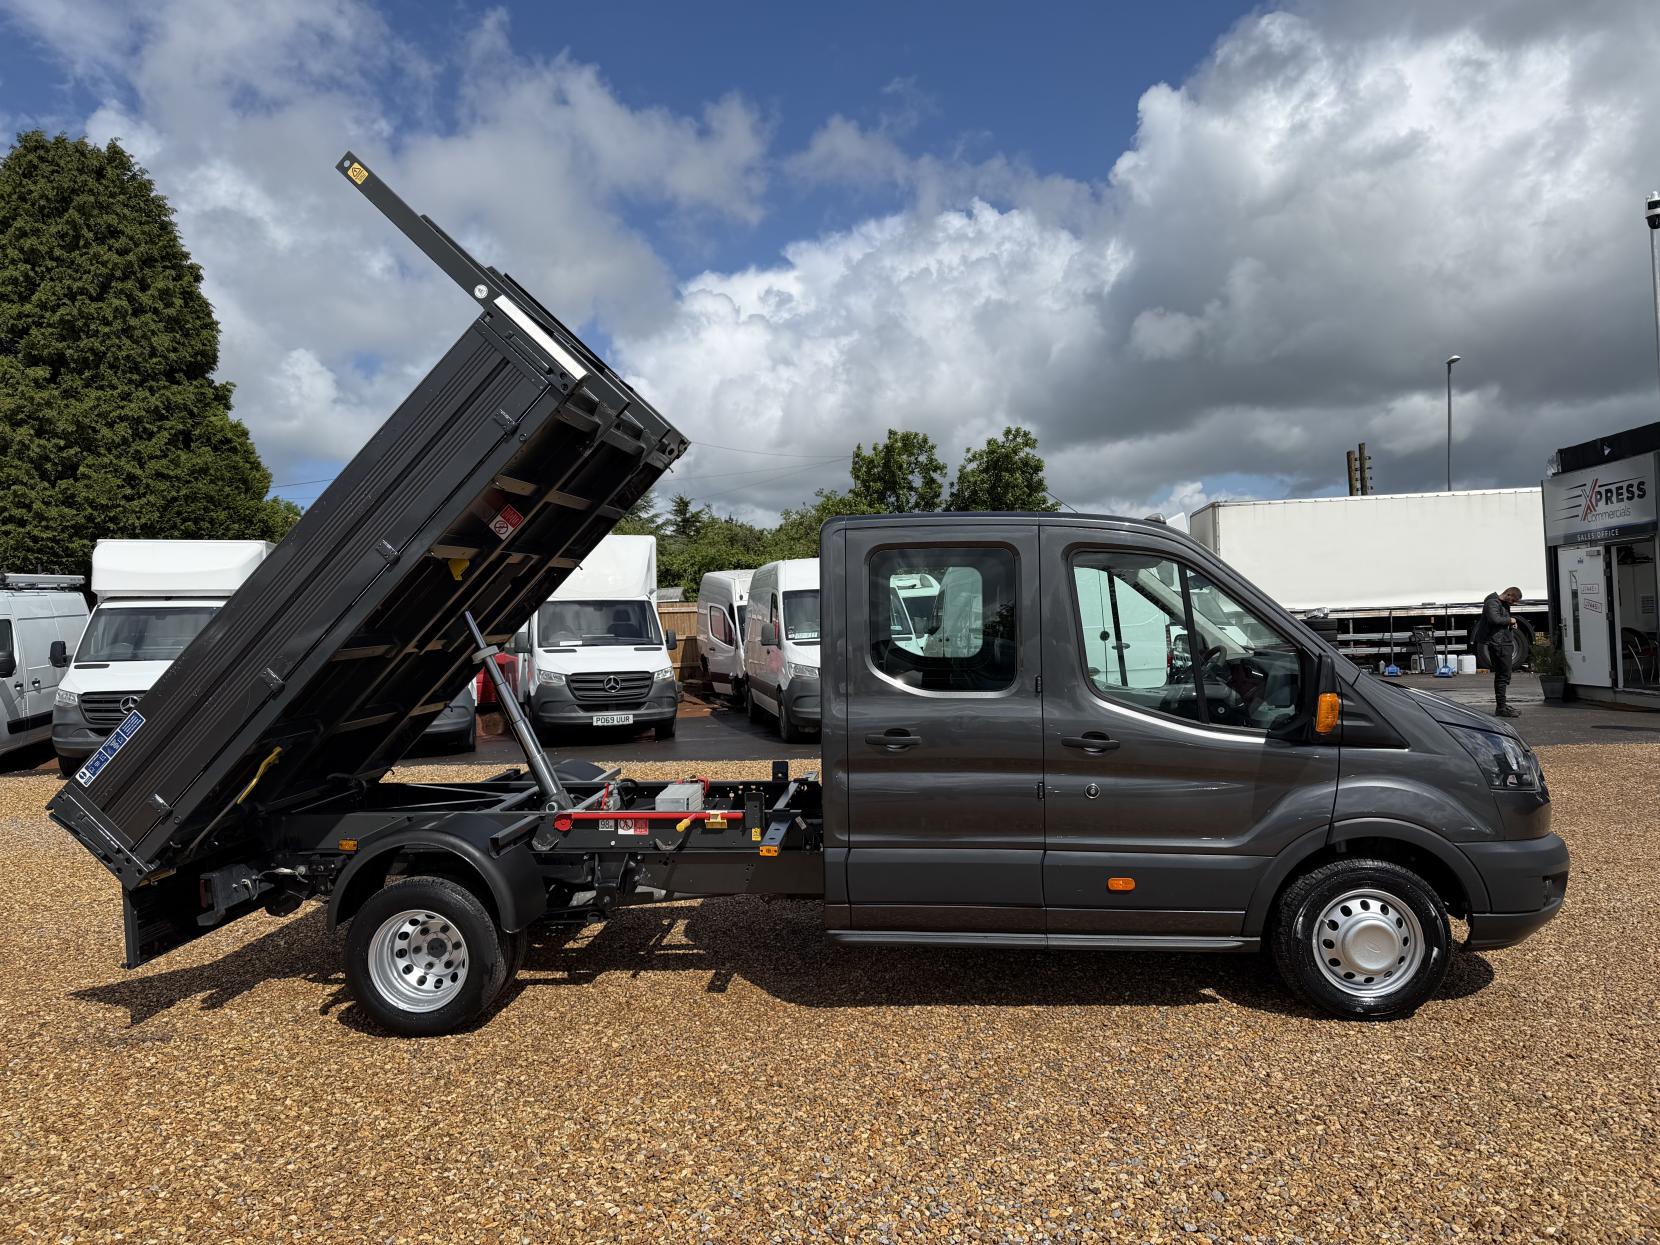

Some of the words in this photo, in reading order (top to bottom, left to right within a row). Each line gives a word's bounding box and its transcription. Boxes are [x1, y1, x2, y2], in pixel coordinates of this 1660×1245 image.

[1581, 478, 1647, 521] XPRESS
[1586, 505, 1632, 522] Commercials
[1577, 532, 1595, 541] SALES
[1597, 529, 1619, 539] OFFICE
[596, 716, 615, 724] PO69
[617, 714, 630, 723] UUR
